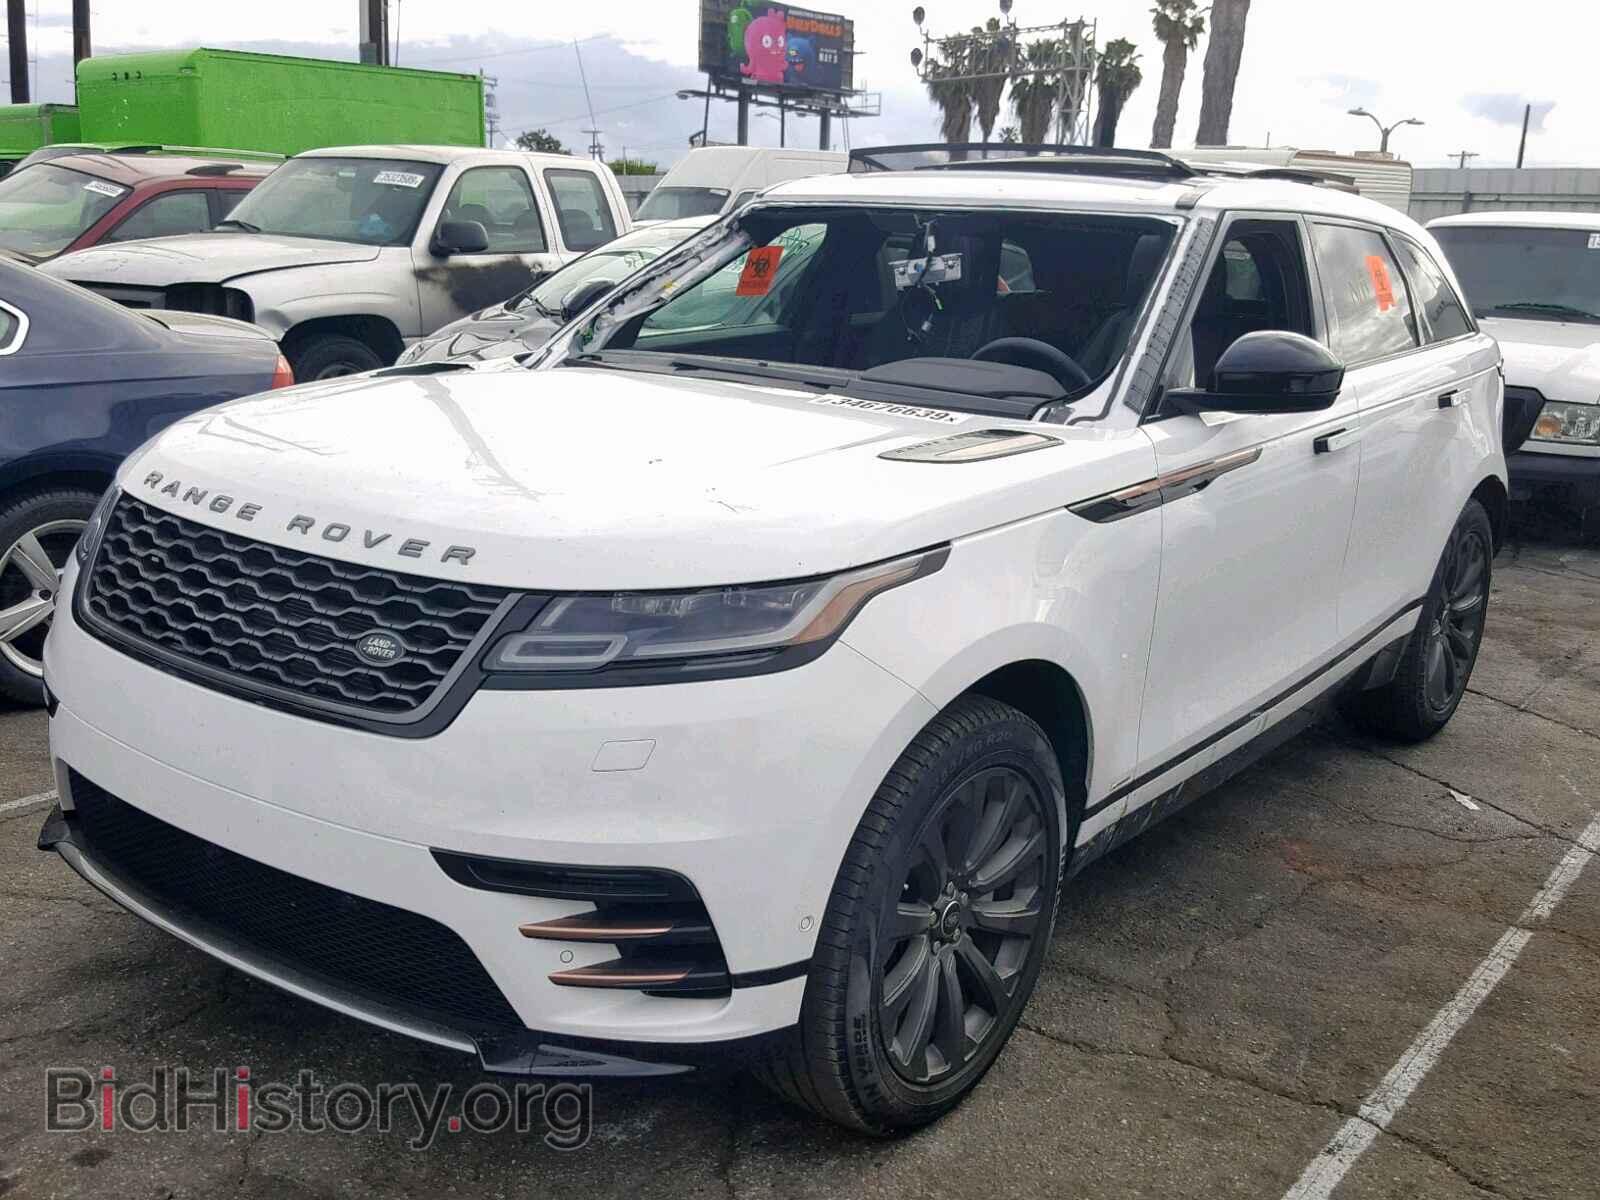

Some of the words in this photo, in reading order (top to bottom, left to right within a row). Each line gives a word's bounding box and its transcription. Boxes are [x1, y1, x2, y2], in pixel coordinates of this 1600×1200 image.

[143, 470, 263, 522] RANGE
[286, 514, 477, 565] ROVER
[367, 637, 391, 649] LAND
[366, 646, 396, 659] ROVER
